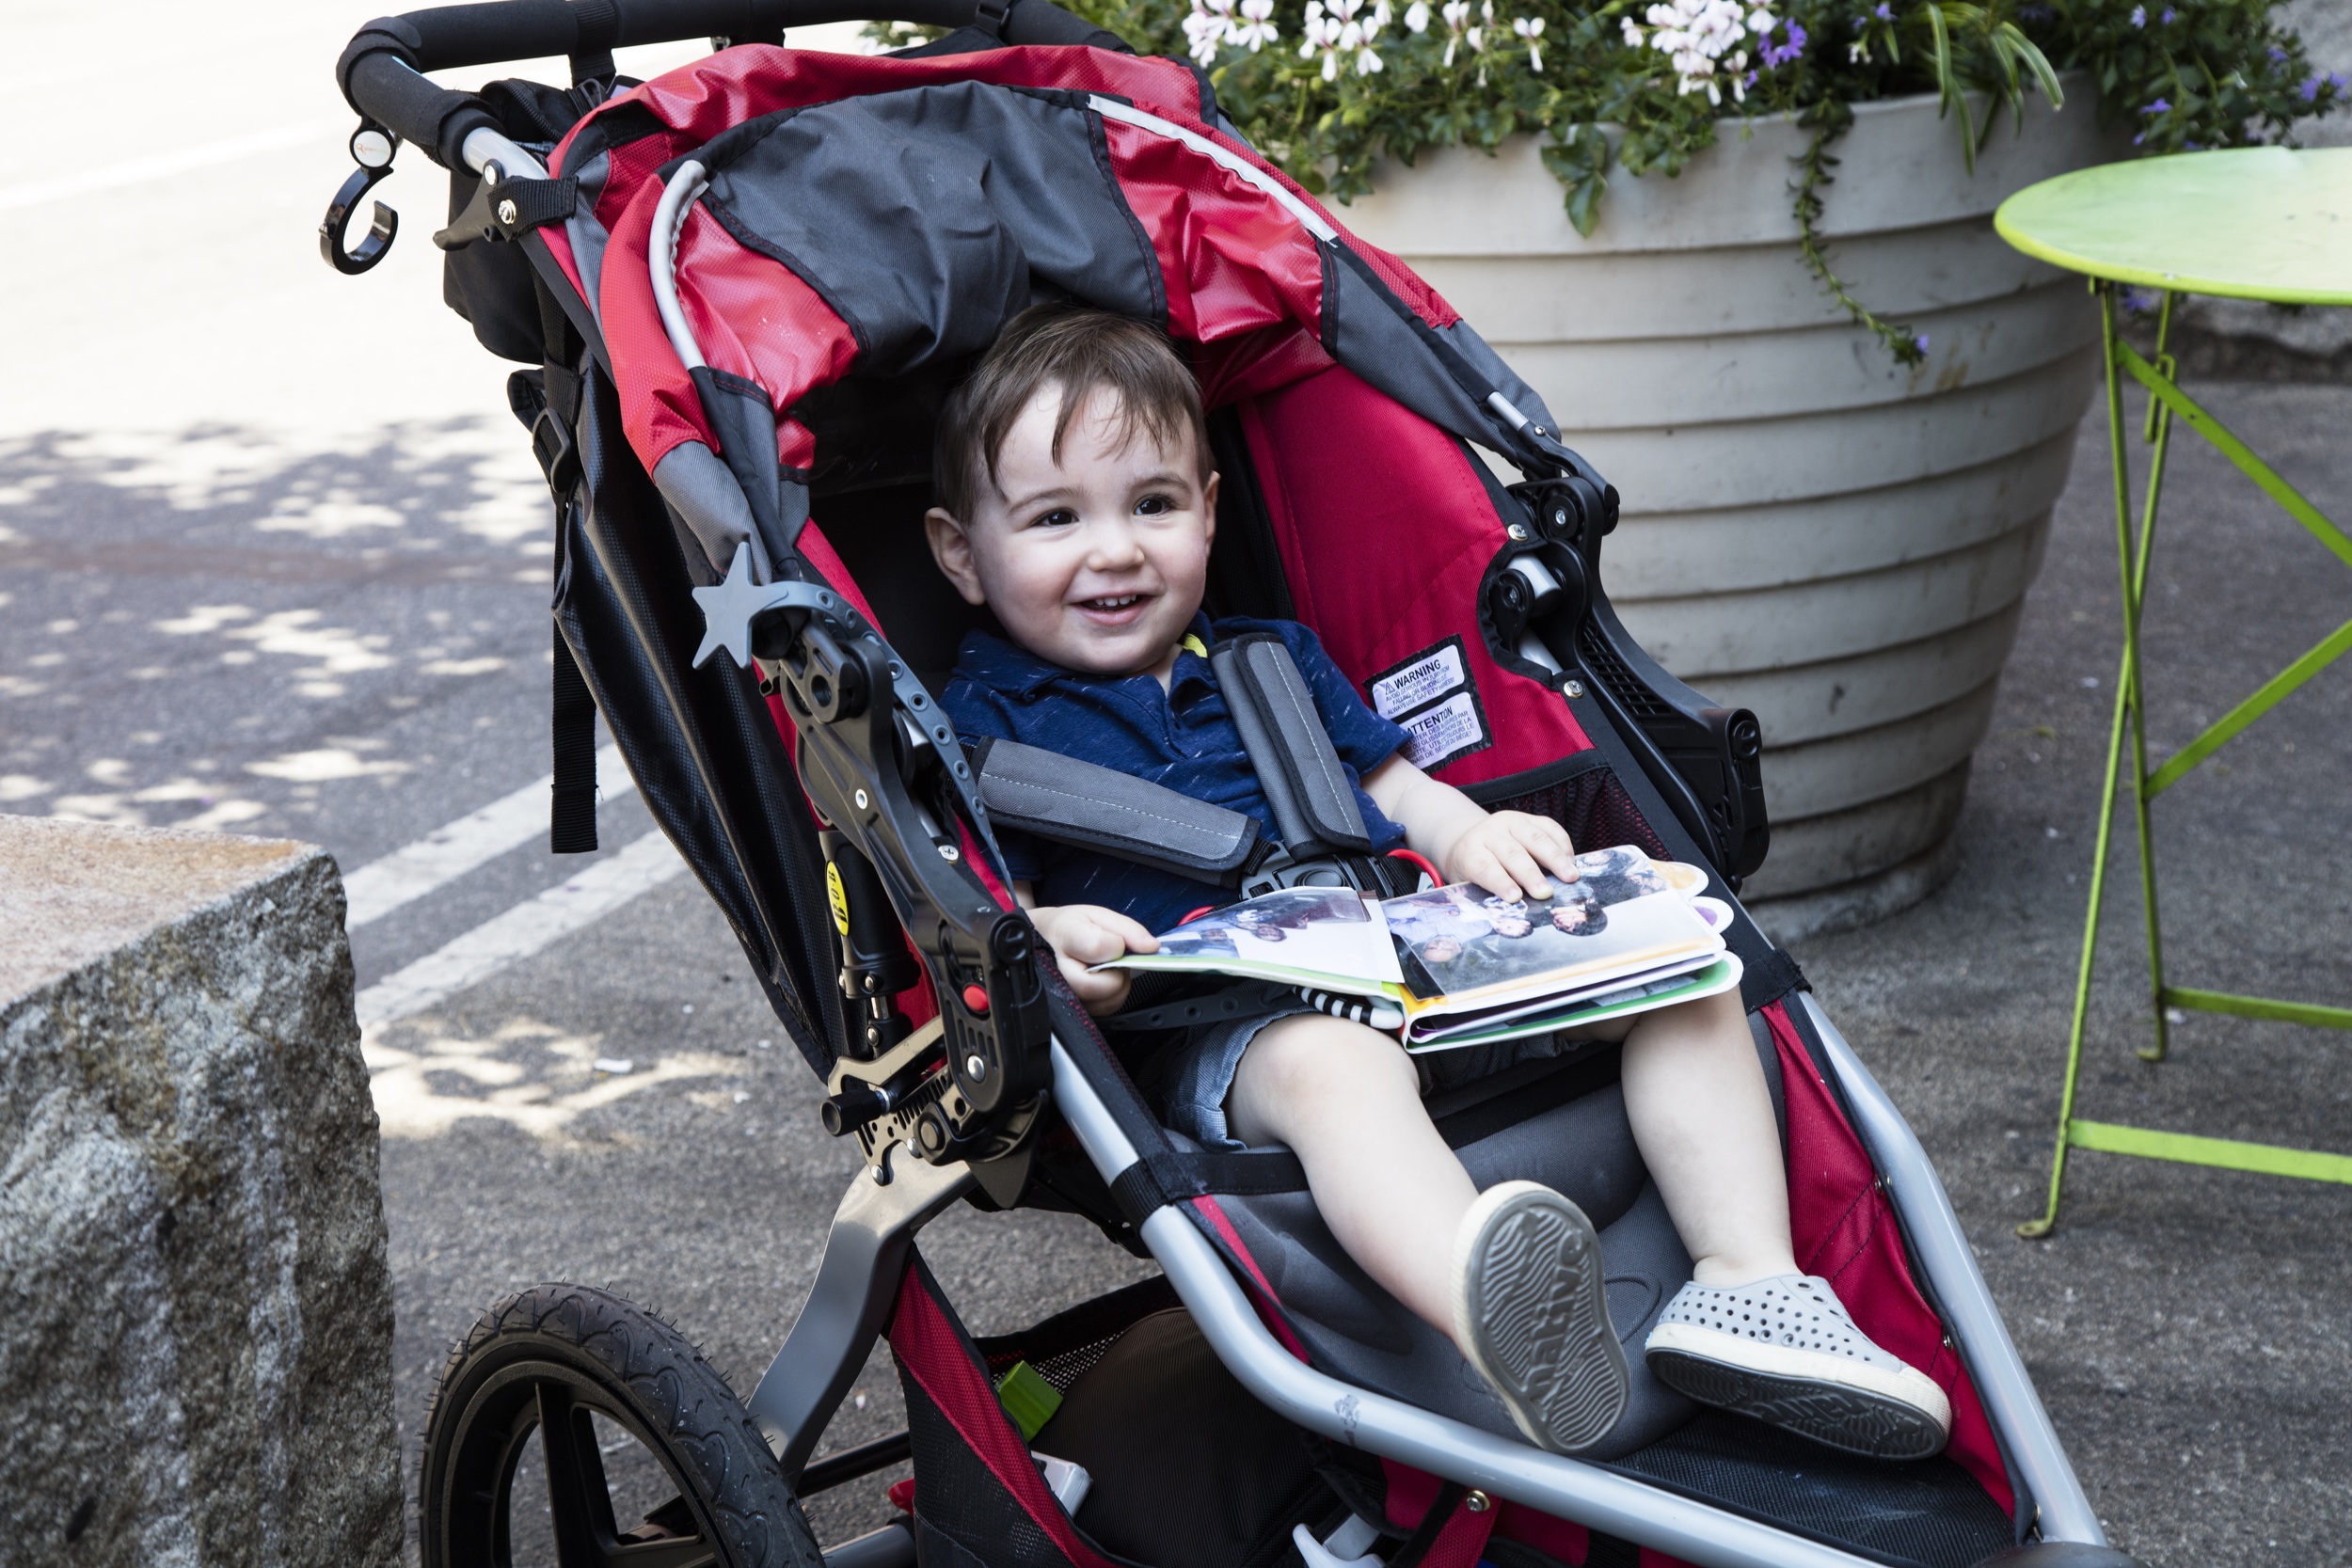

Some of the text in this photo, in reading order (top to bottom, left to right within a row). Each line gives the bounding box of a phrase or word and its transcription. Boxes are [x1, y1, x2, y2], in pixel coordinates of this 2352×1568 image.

[1394, 659, 1440, 689] WARNING
[1400, 679, 1422, 694] SERIOUS
[1406, 697, 1416, 705] USE
[1416, 685, 1438, 701] SAFETY
[1411, 688, 1420, 696] OR
[1428, 724, 1440, 735] DES
[1457, 710, 1469, 719] PAR
[1466, 721, 1473, 730] LE
[1424, 750, 1434, 758] DE
[1522, 1227, 1592, 1422] native
